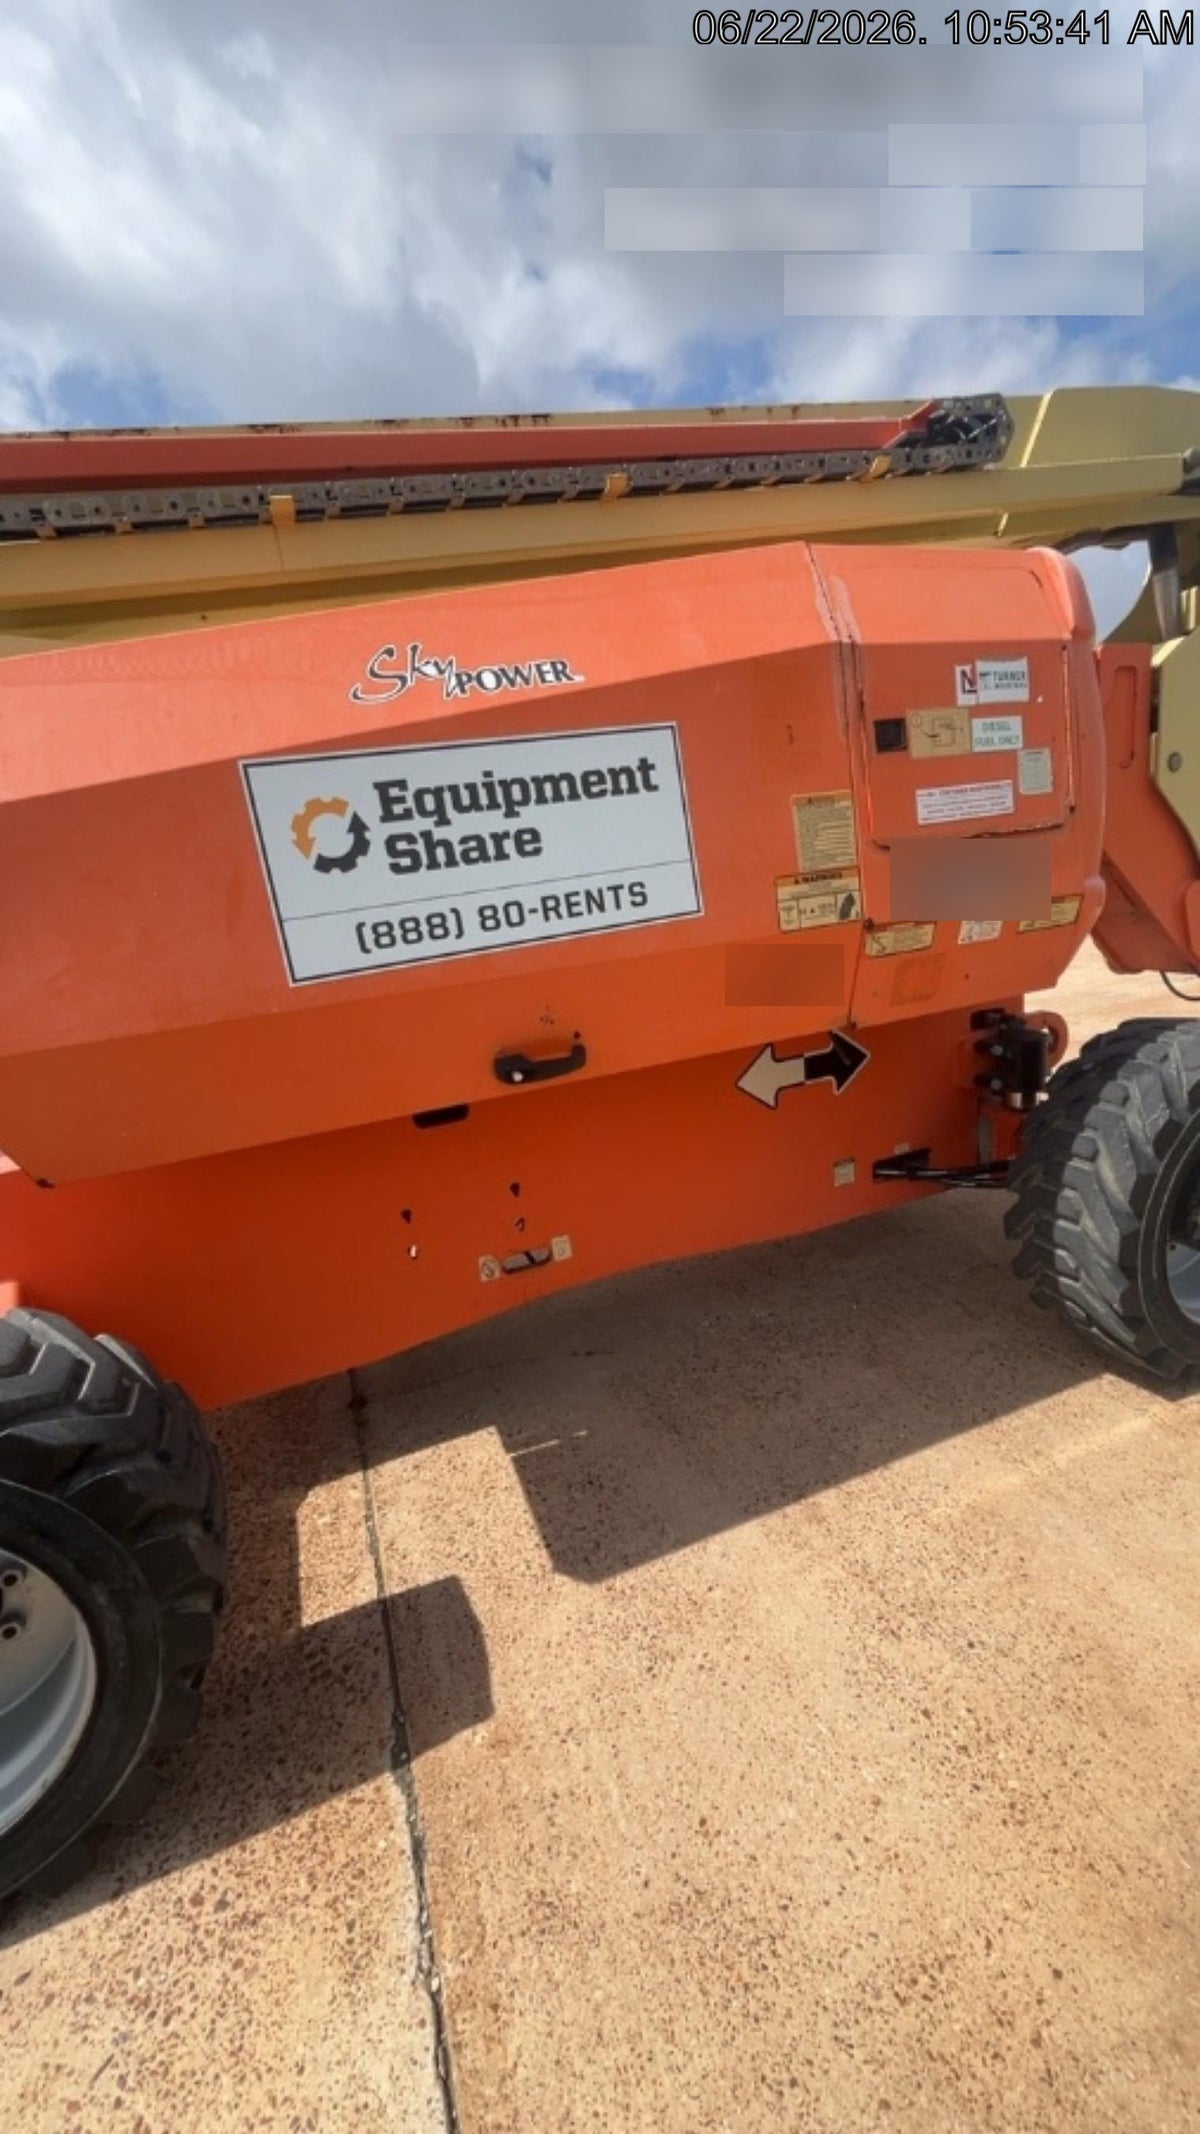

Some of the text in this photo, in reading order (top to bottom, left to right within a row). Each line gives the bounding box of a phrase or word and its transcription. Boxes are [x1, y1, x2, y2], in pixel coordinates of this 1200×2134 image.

[372, 757, 659, 826] Equipment
[385, 826, 543, 875] Share
[355, 881, 648, 954] (888) 80-RENTS
